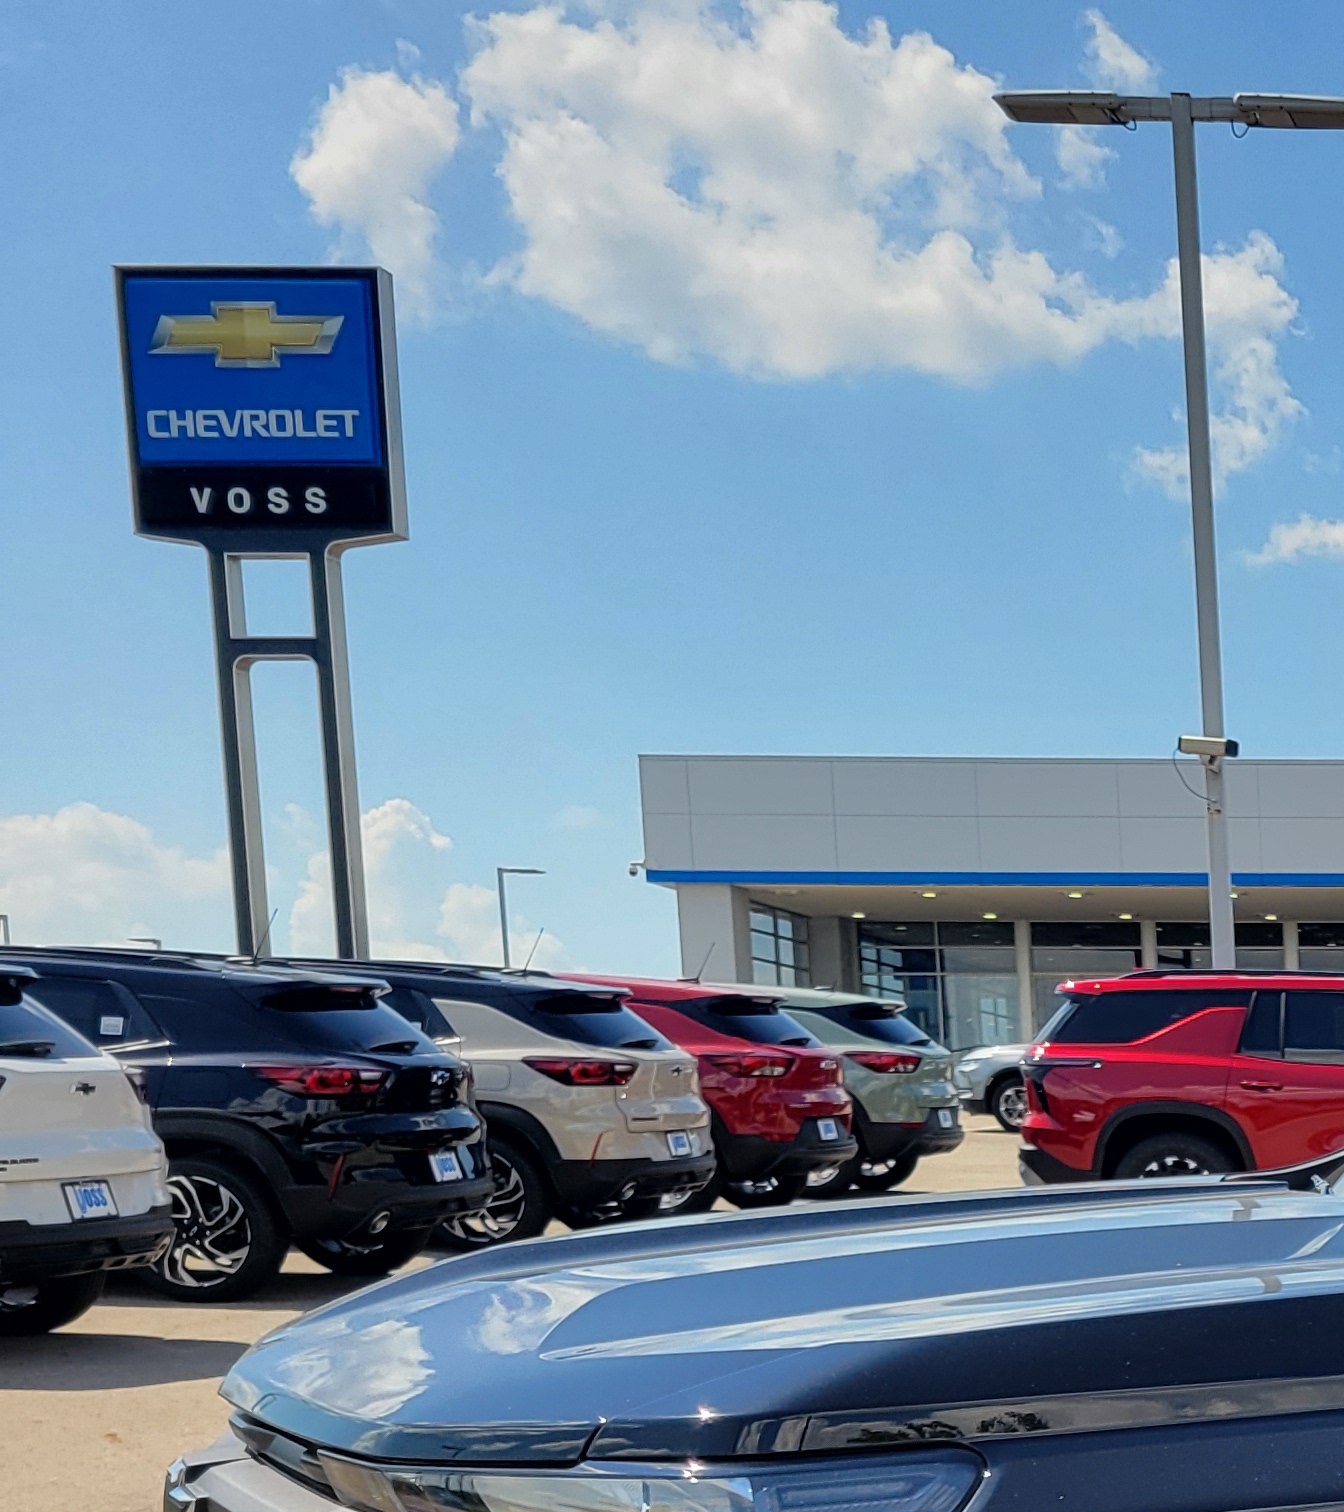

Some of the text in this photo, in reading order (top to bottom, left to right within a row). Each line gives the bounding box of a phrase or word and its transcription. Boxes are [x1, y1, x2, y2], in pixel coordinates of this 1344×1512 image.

[146, 409, 360, 438] CHEVROLET
[190, 487, 327, 514] VOSS
[74, 1187, 108, 1214] VOSS
